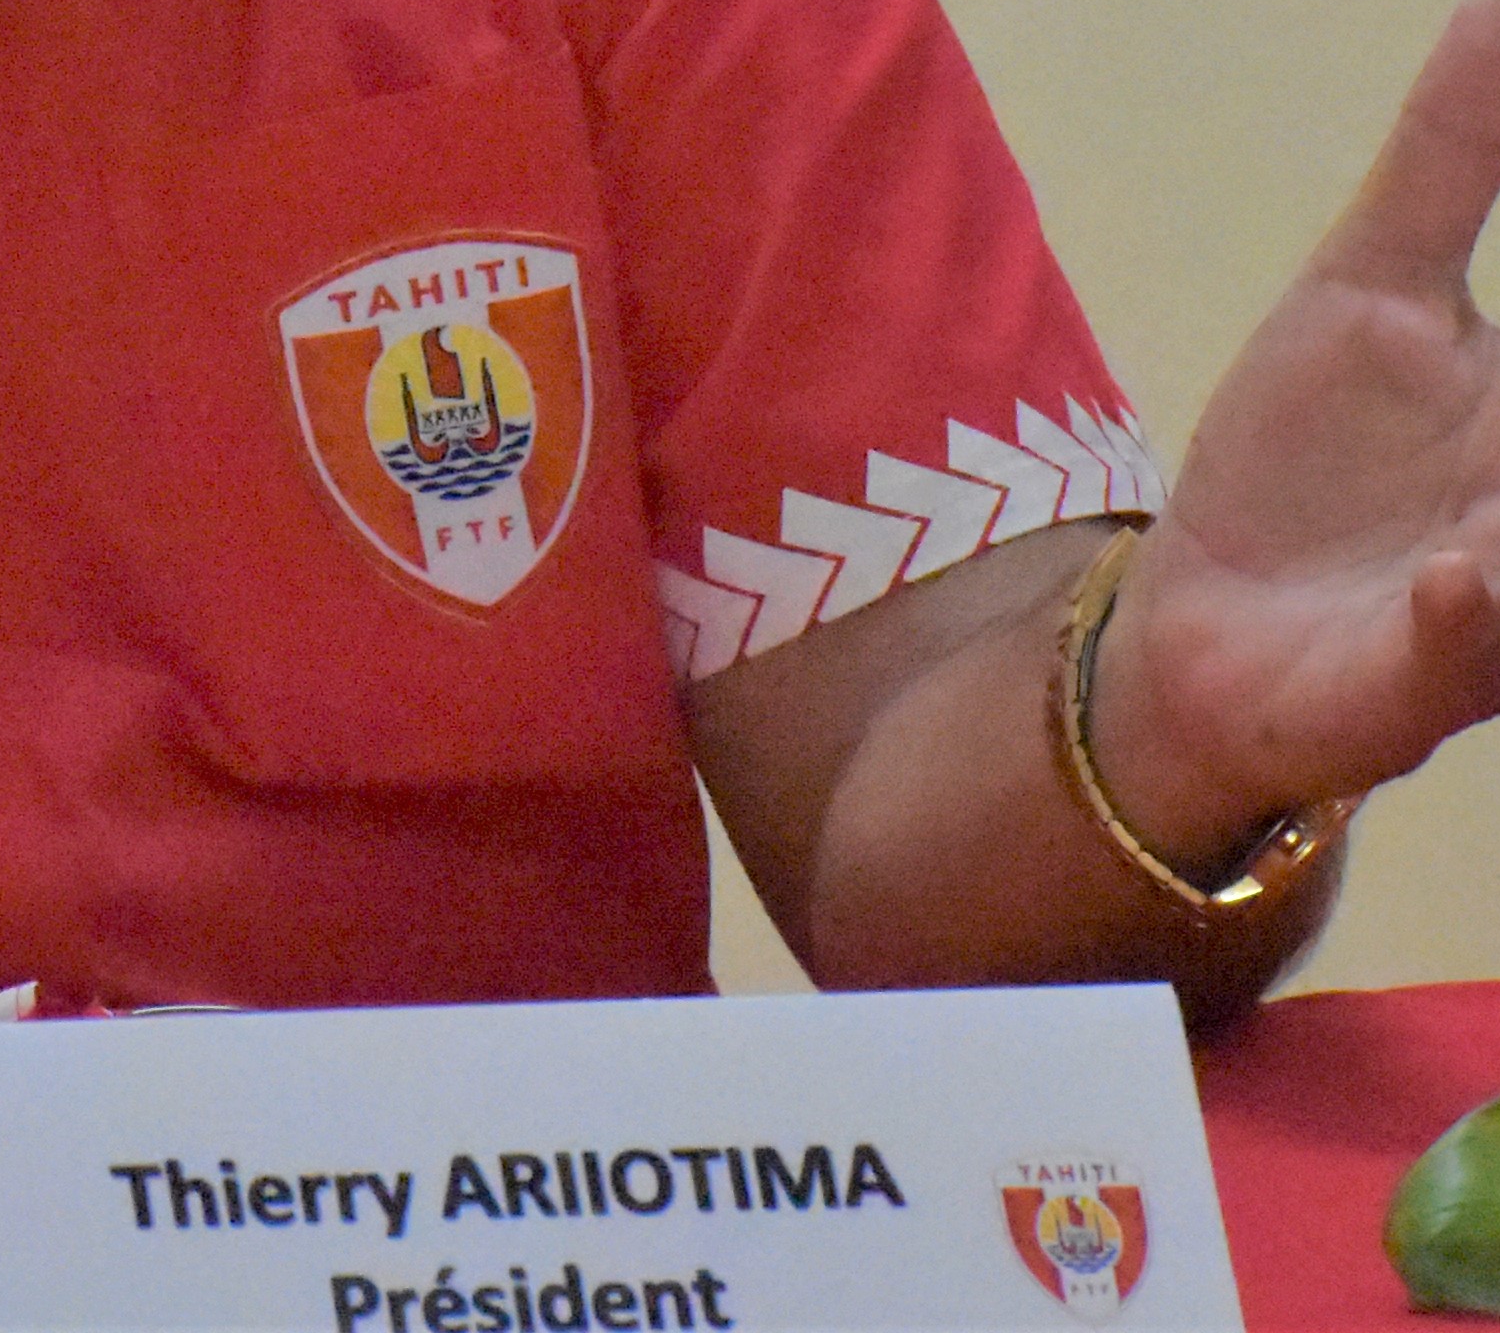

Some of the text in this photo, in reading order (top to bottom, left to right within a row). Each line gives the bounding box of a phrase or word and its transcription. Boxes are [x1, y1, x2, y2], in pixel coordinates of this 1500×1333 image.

[328, 256, 530, 323] TAHITI
[434, 515, 518, 552] FTF
[108, 1142, 907, 1239] Thierry ARIIOTIMA
[1018, 1162, 1116, 1182] TAHITI
[330, 1261, 737, 1333] Président
